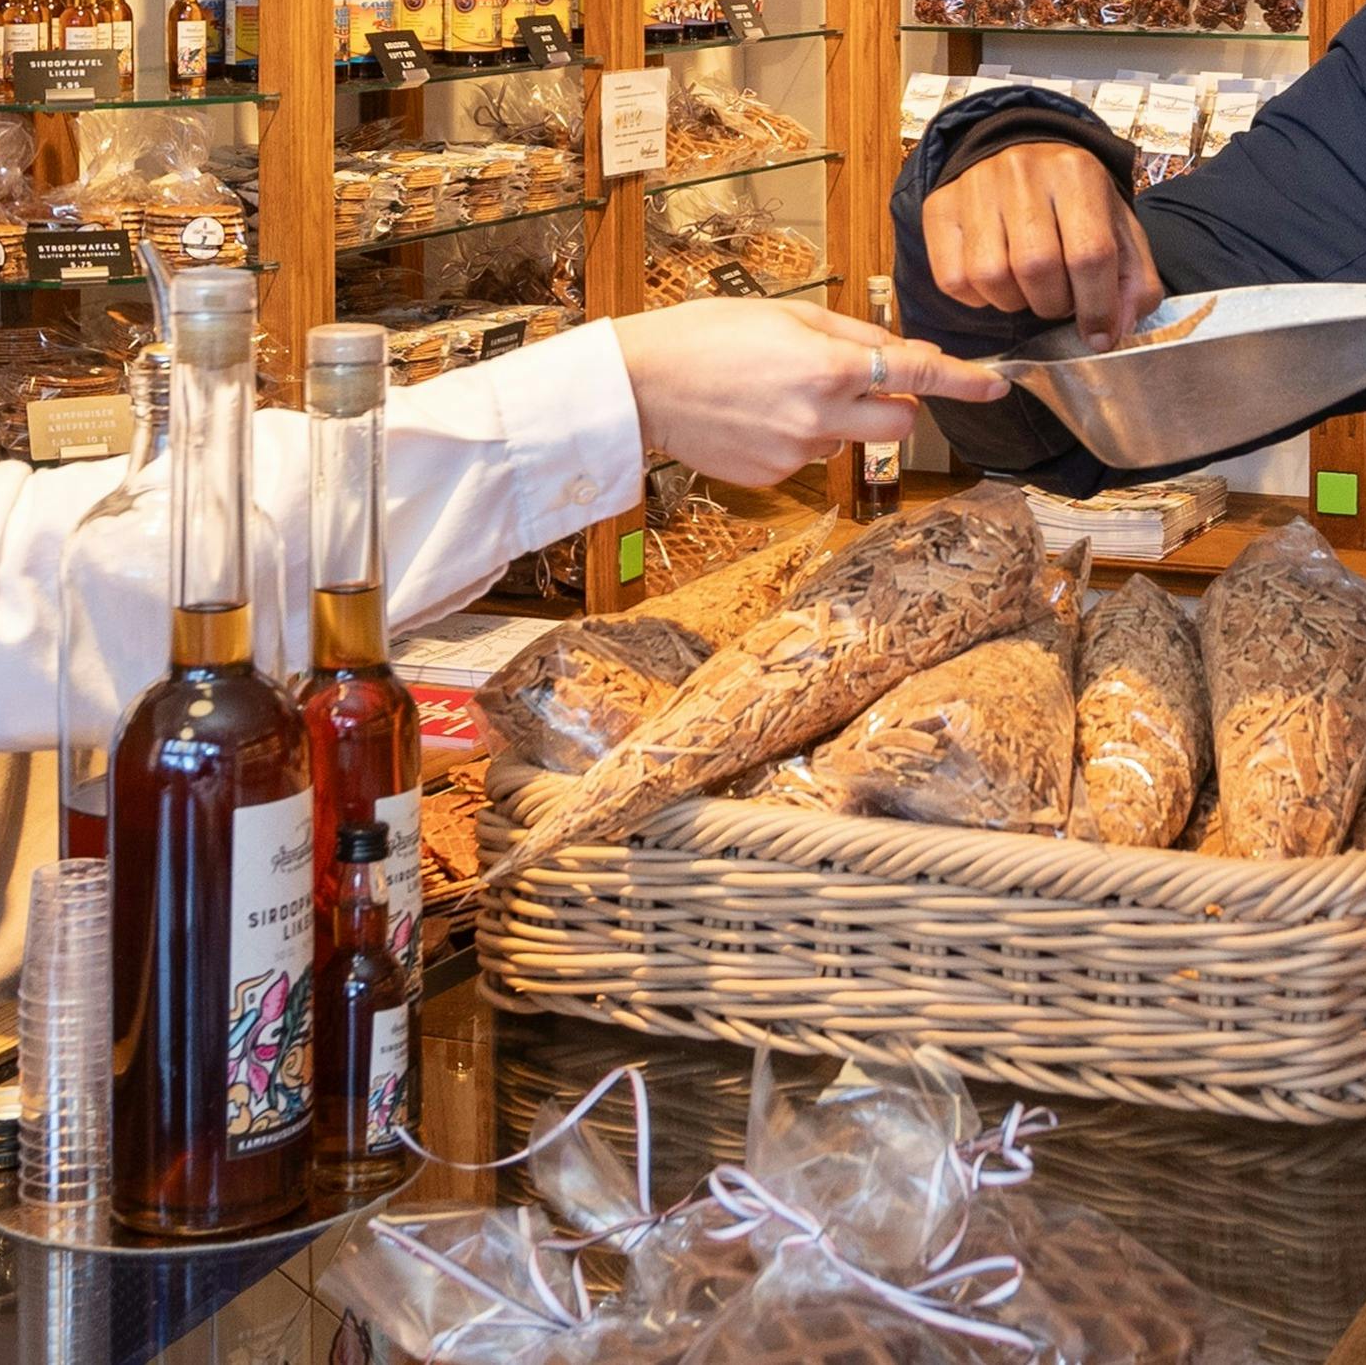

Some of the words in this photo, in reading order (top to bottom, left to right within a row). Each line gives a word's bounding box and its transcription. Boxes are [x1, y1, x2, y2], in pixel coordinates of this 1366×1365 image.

[29, 59, 104, 68] SIROOPWAFEL
[48, 69, 86, 78] LIKEUR
[37, 243, 120, 252] STROOPWAFELS
